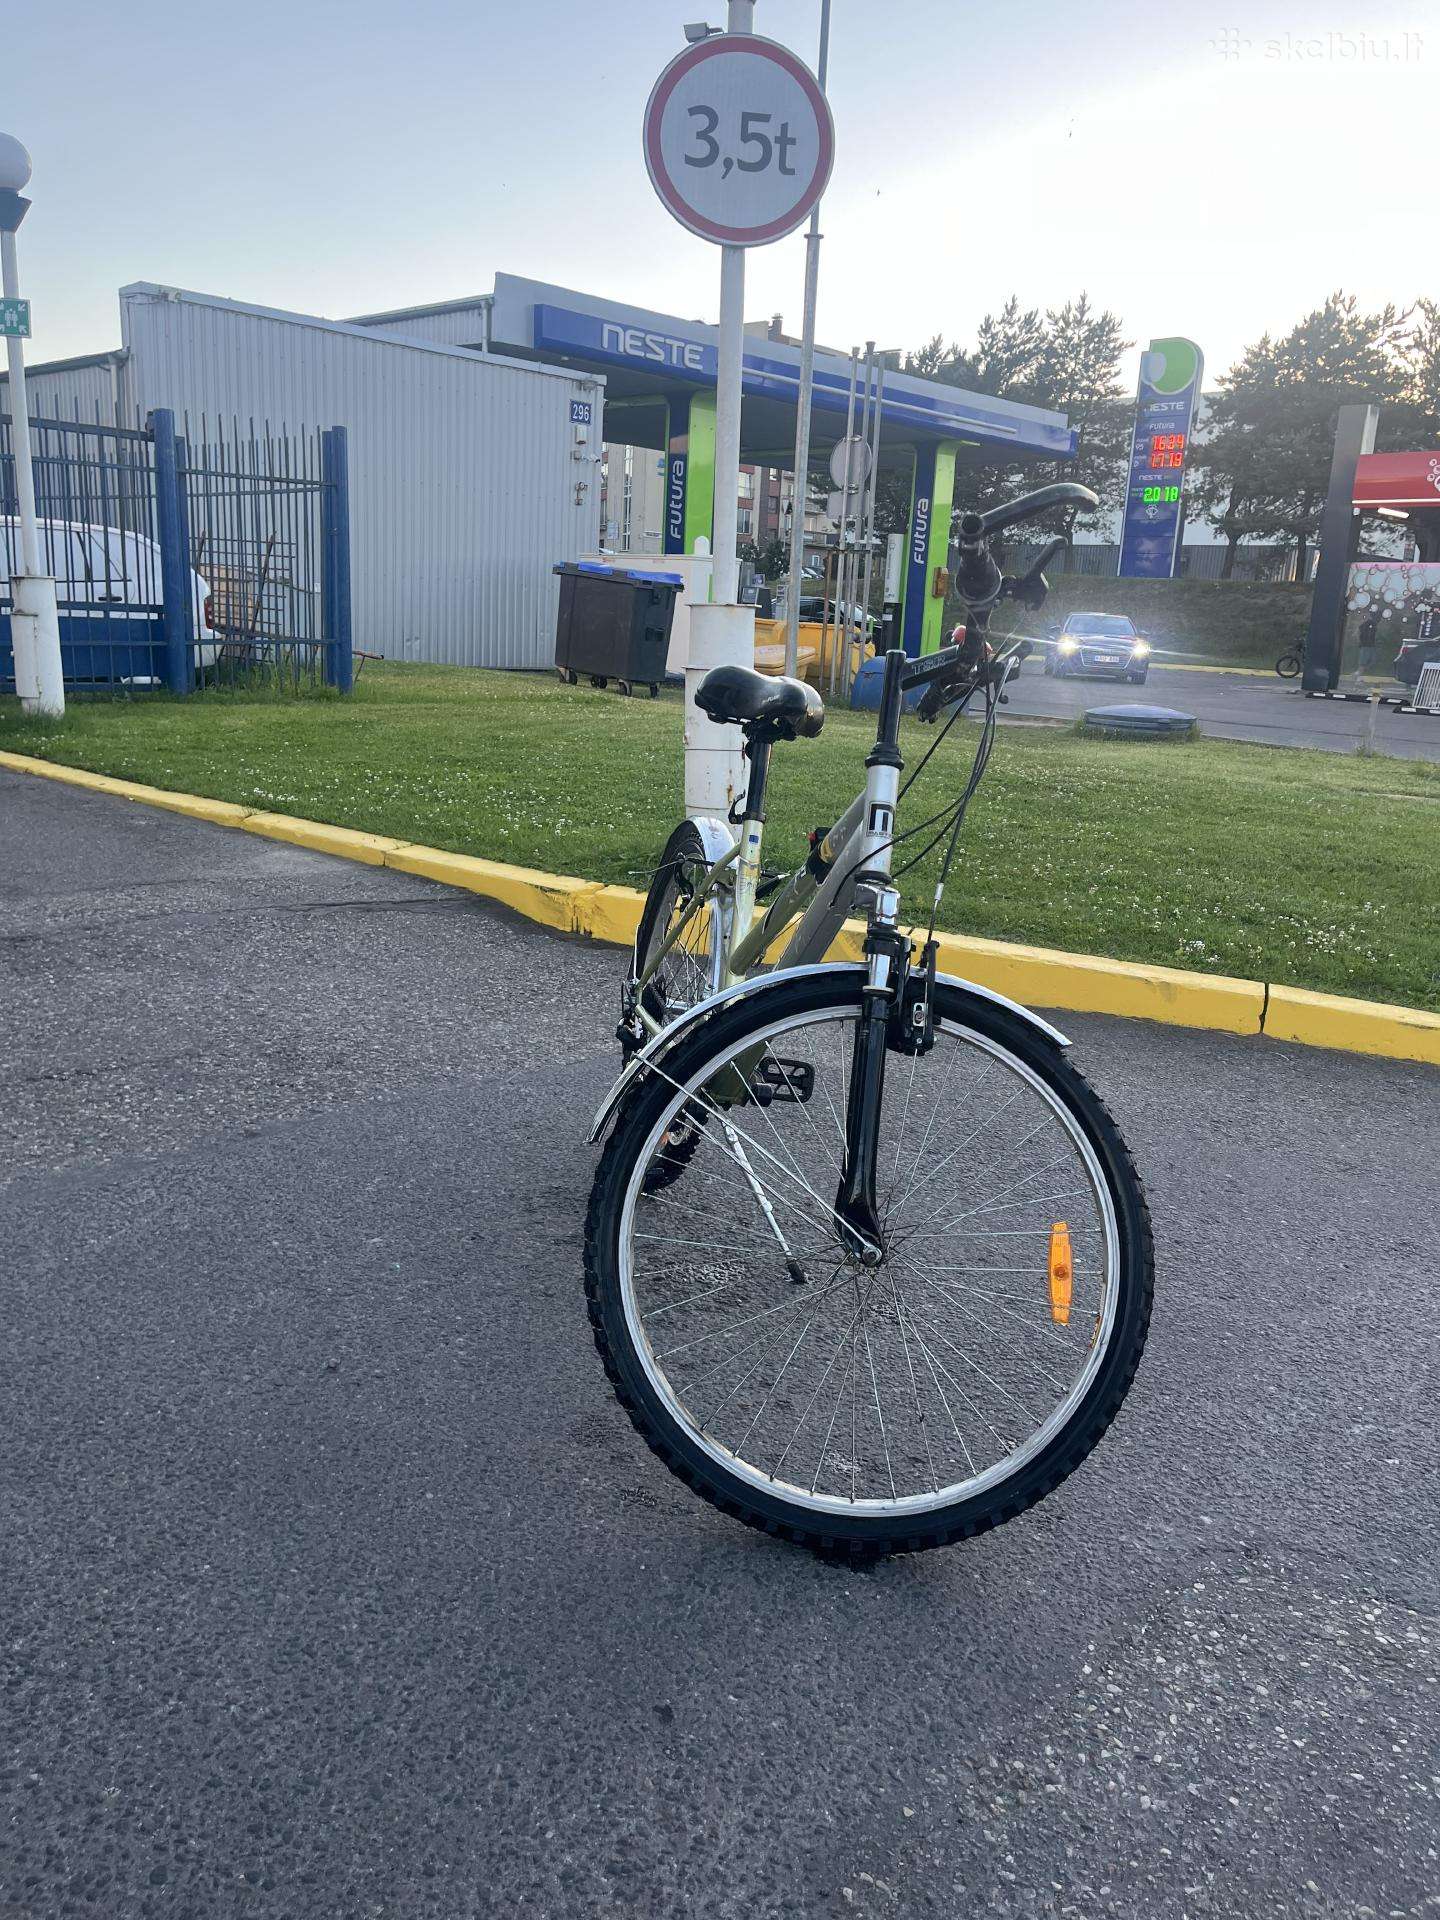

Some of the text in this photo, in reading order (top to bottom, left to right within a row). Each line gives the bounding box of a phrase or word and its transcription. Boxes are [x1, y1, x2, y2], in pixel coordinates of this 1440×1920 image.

[684, 104, 797, 180] 3,5t
[601, 323, 703, 372] NESTE
[572, 403, 590, 422] 296
